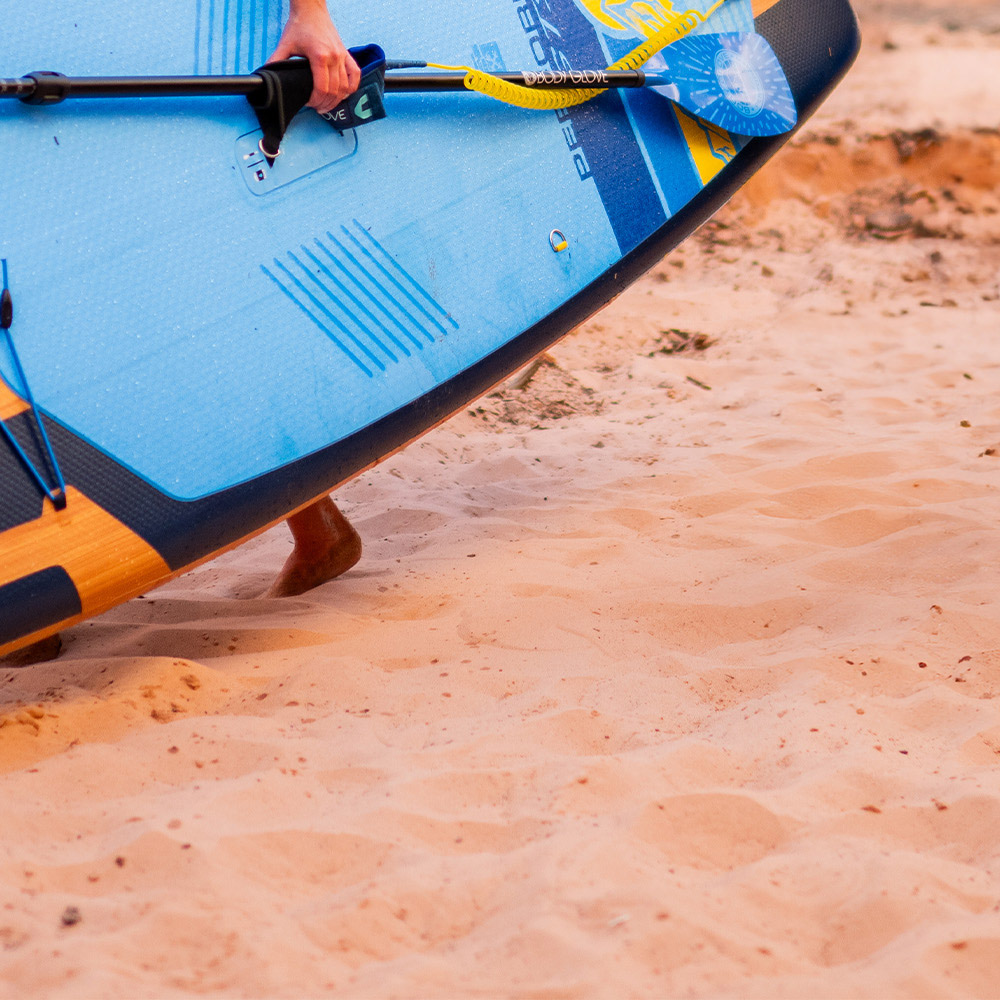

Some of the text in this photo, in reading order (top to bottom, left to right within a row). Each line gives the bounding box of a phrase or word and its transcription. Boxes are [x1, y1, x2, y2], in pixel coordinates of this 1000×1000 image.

[536, 69, 609, 84] BODY GLOVE
[321, 108, 346, 121] OVE
